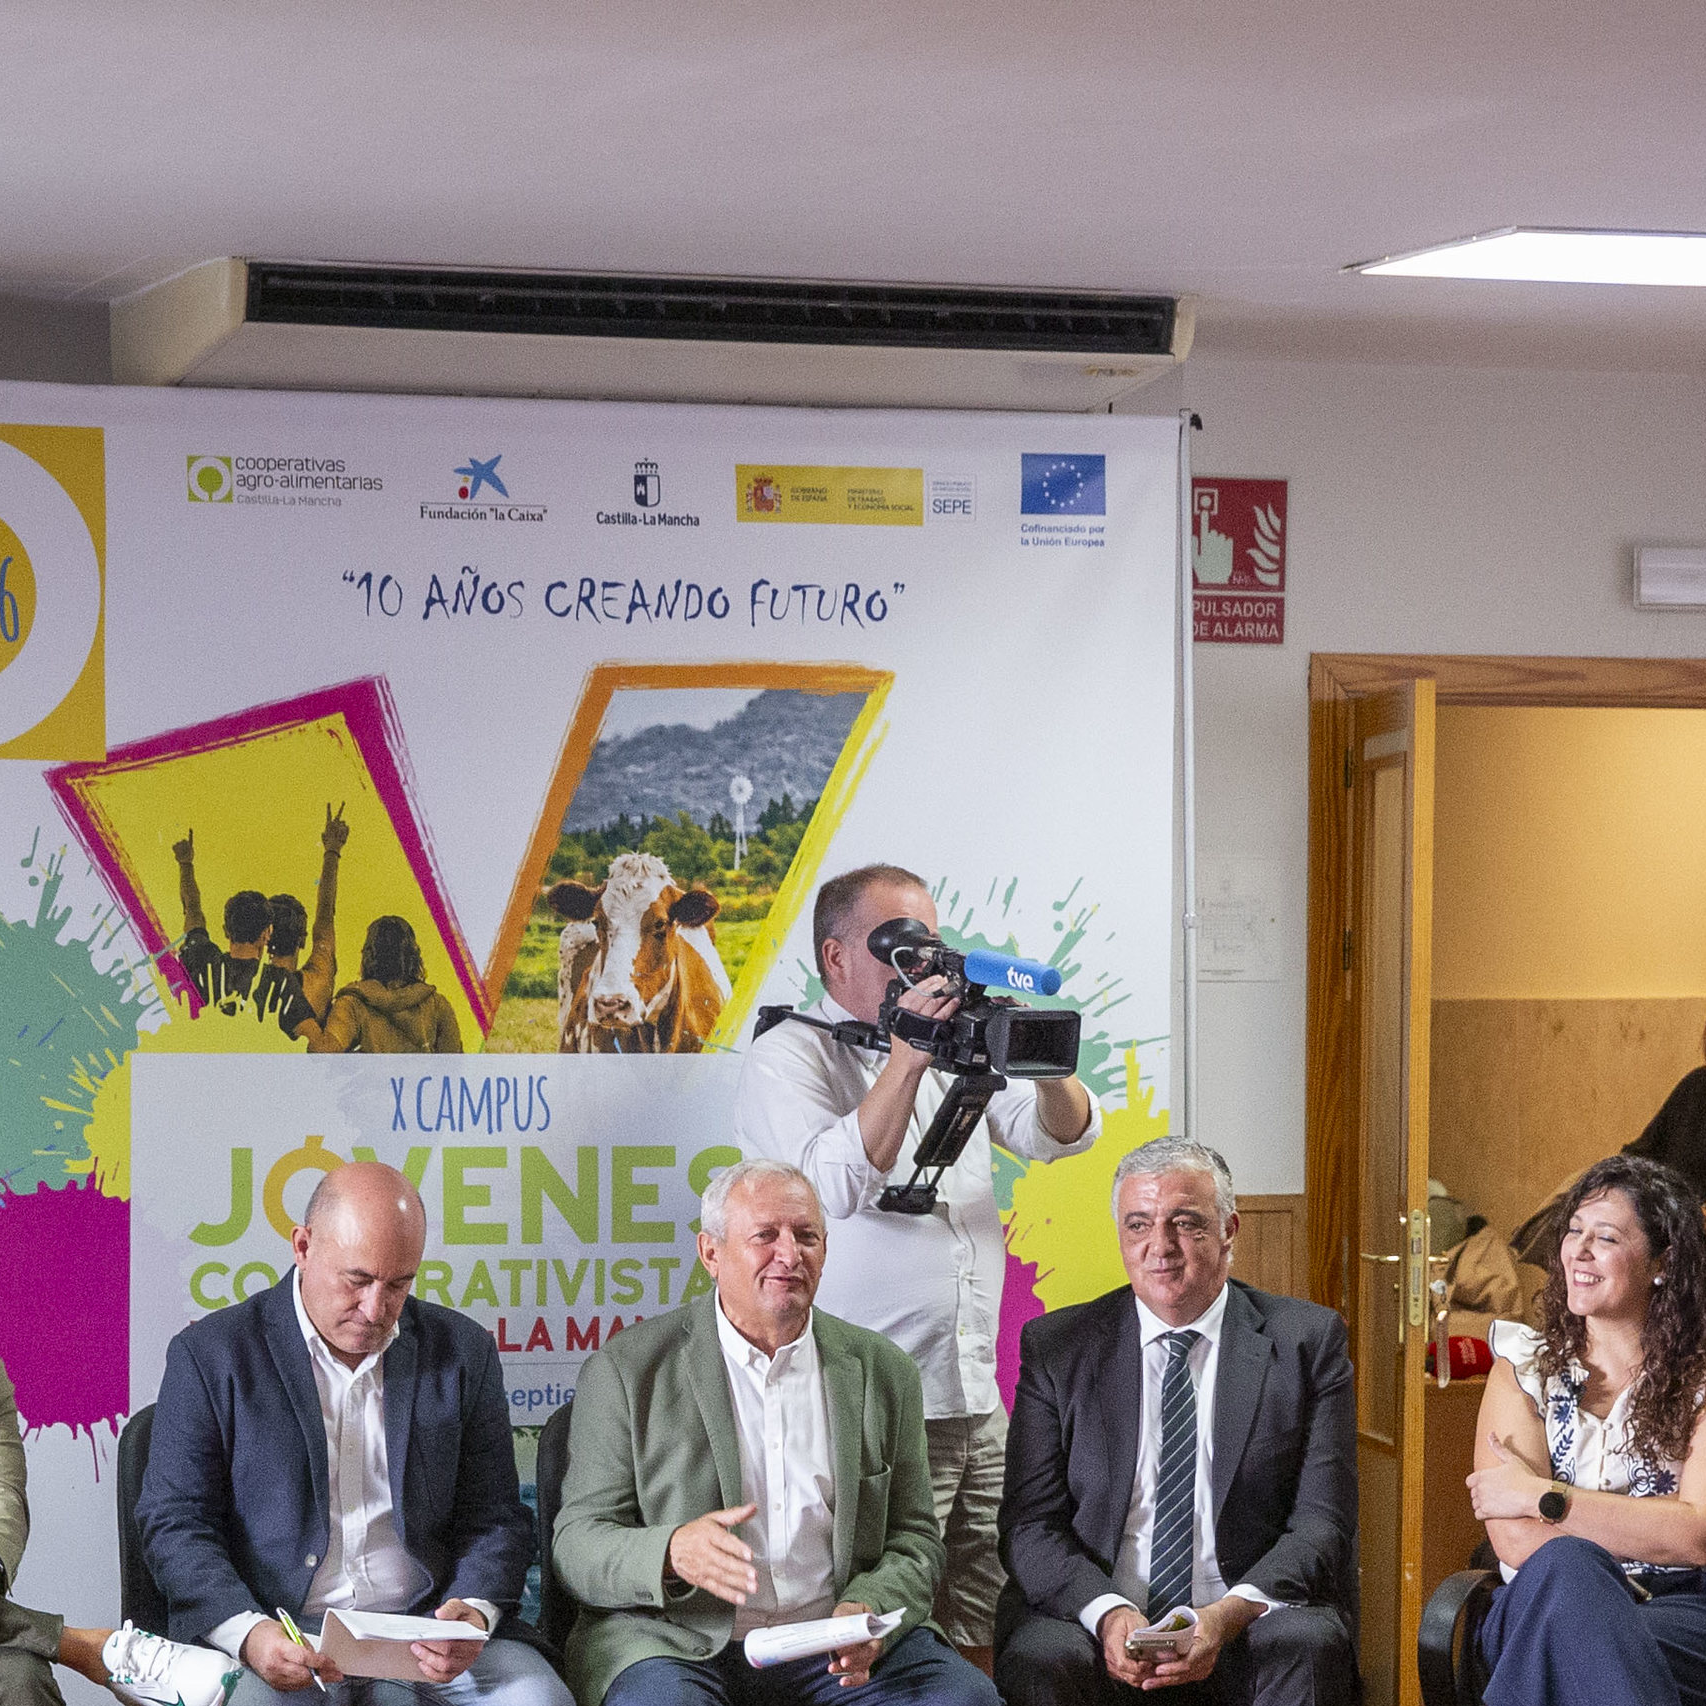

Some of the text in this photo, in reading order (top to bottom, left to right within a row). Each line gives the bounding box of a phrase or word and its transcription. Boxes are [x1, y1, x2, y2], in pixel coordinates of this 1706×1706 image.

[235, 456, 346, 473] cooperativas
[236, 473, 383, 491] agro-alimentarias
[420, 506, 487, 521] Fundación
[933, 498, 972, 514] SEPE
[1021, 523, 1105, 535] Cofinanciado por
[1021, 536, 1105, 547] la Unión Europea
[423, 565, 525, 620] AÑOS
[545, 576, 730, 625] CREANDO
[1193, 601, 1276, 618] PULSADOR
[1213, 621, 1279, 638] ALARMA
[1007, 966, 1034, 994] tve
[391, 1075, 551, 1134] X CAMPUS
[189, 1258, 713, 1310] CORATIVISTA
